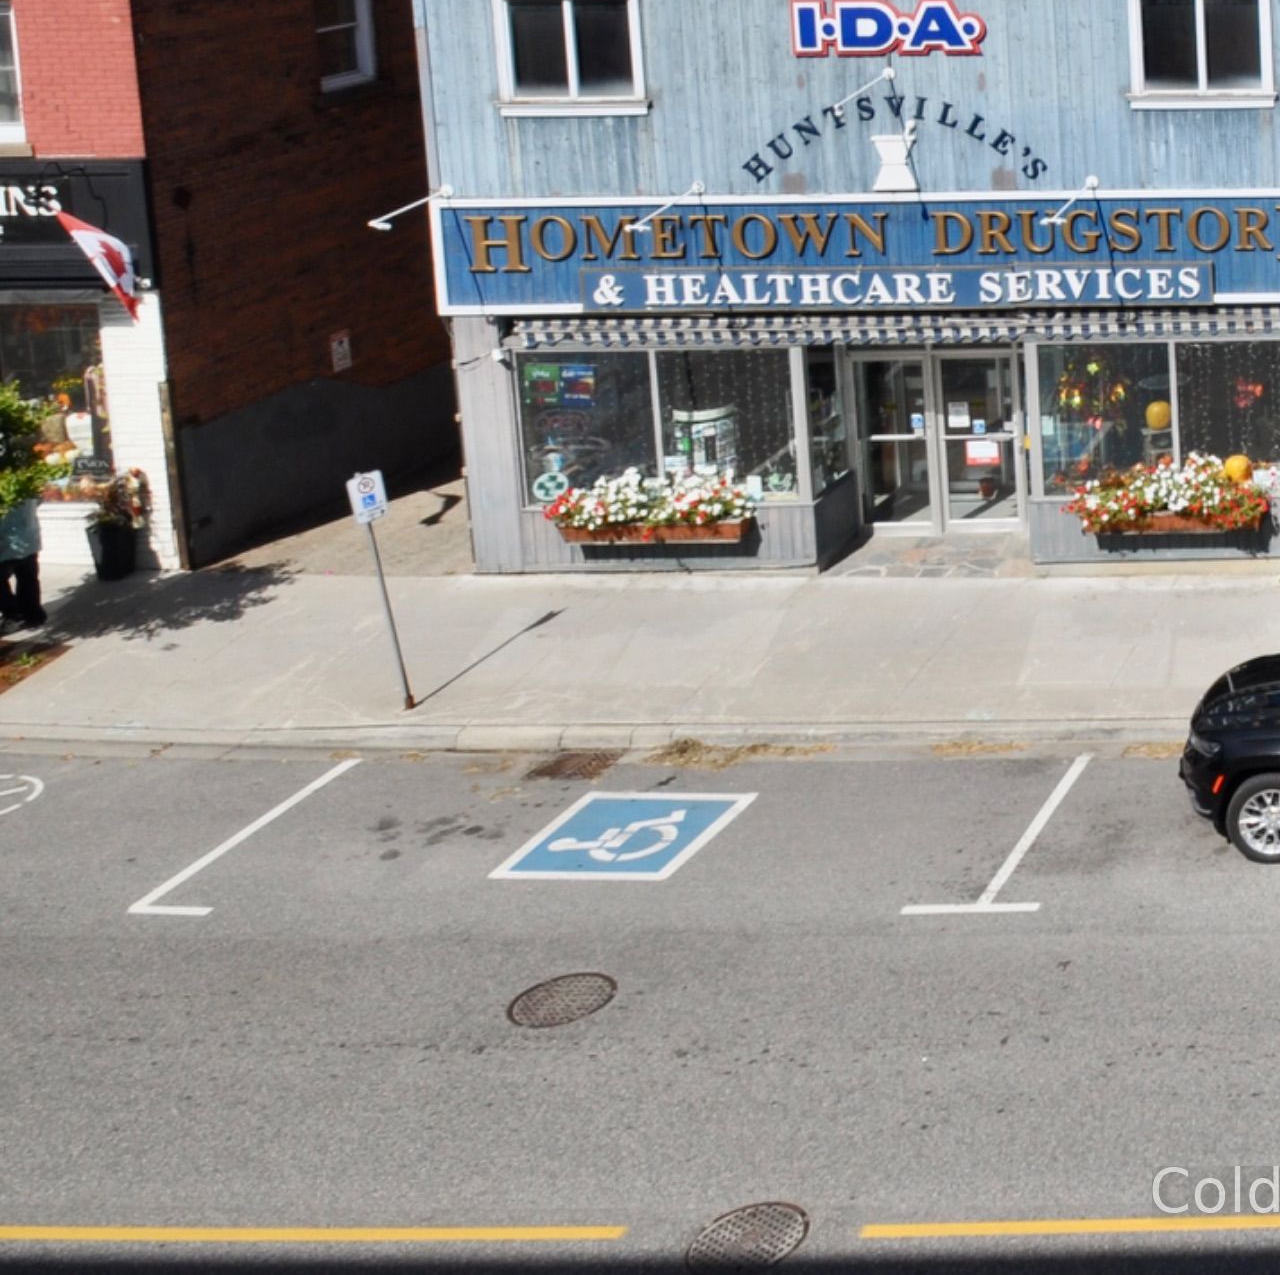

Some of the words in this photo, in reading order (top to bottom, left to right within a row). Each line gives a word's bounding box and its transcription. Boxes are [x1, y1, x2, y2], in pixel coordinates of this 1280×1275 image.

[742, 95, 1048, 183] HUNTSVILLE'S
[463, 212, 890, 274] HOMETOWN
[592, 273, 626, 306] &
[642, 271, 957, 308] HEALTHCARE
[979, 266, 1202, 305] SERVICES
